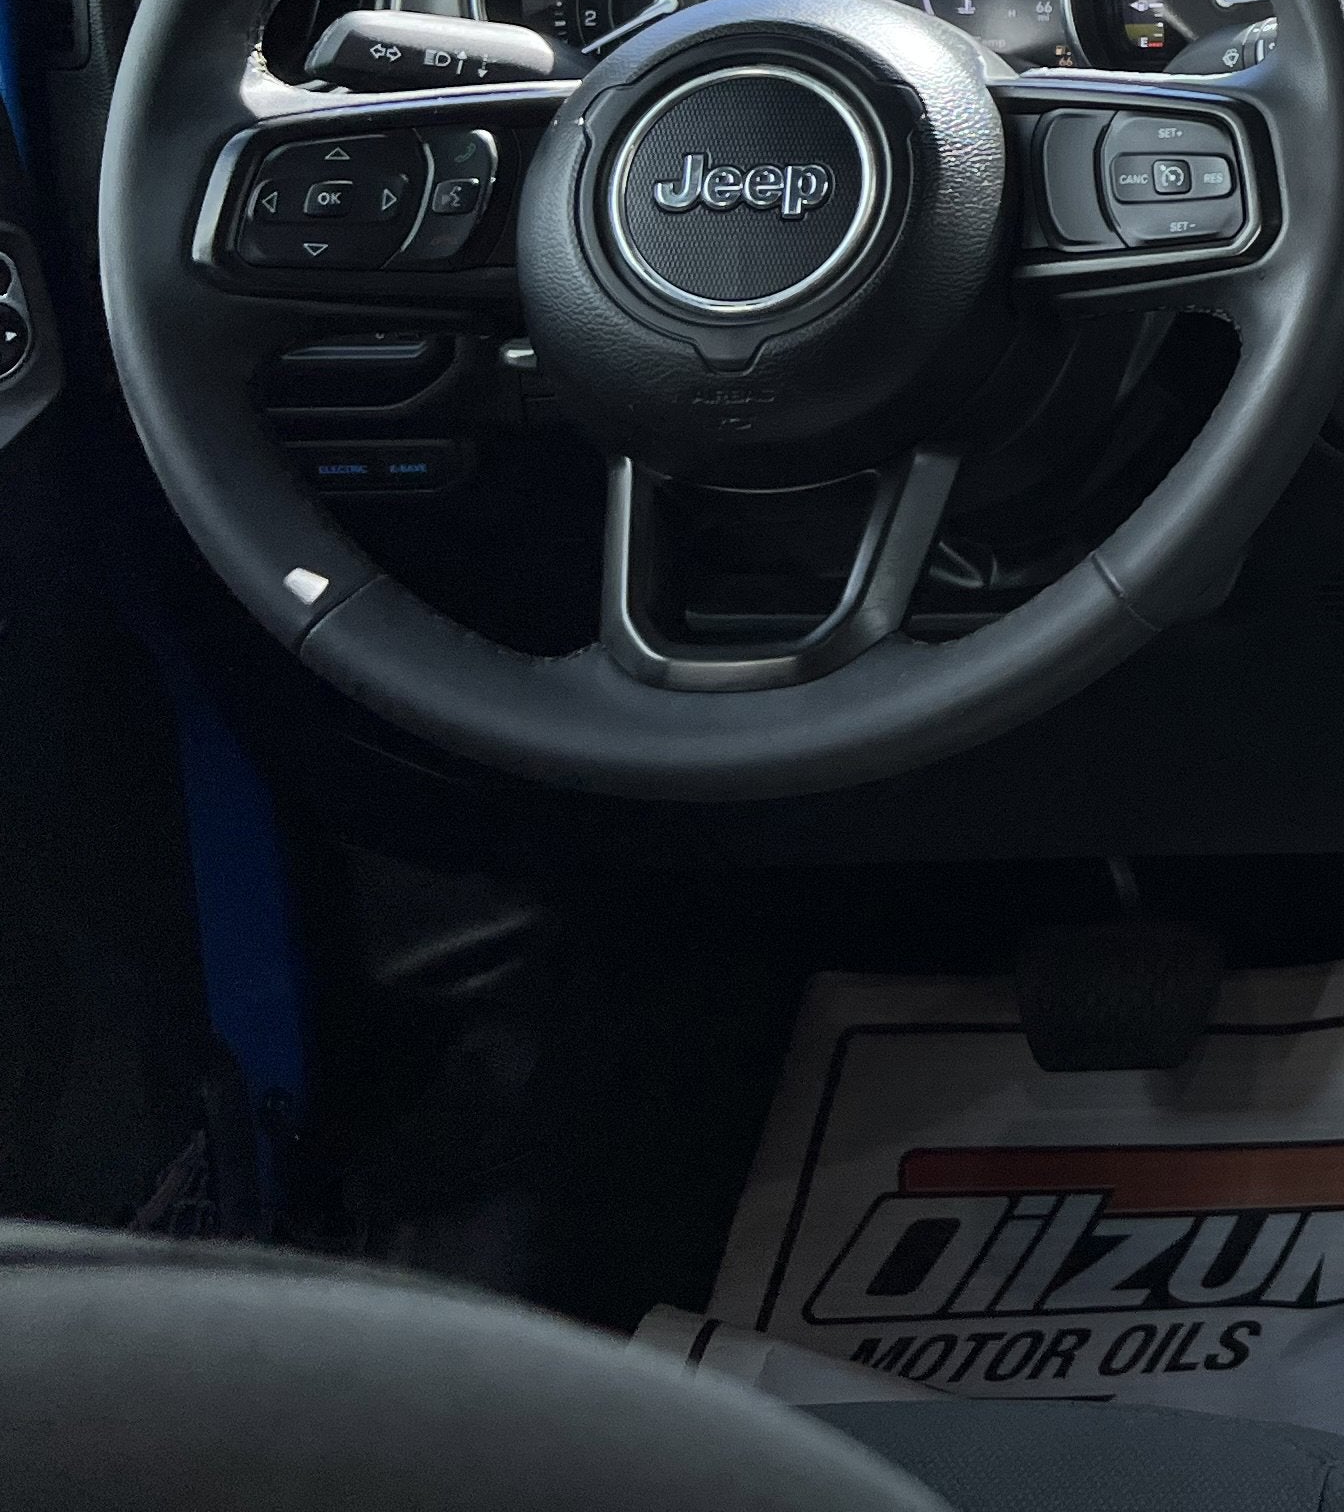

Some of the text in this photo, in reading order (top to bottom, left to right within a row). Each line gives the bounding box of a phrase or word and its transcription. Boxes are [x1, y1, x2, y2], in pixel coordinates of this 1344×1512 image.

[1036, 2, 1053, 14] 66
[584, 10, 597, 27] 2
[1139, 37, 1148, 48] E
[1119, 173, 1149, 185] CANC
[1204, 172, 1224, 184] RES
[654, 153, 829, 219] Jeep
[317, 191, 342, 207] OK
[849, 1320, 1265, 1386] MOTOR OILS
